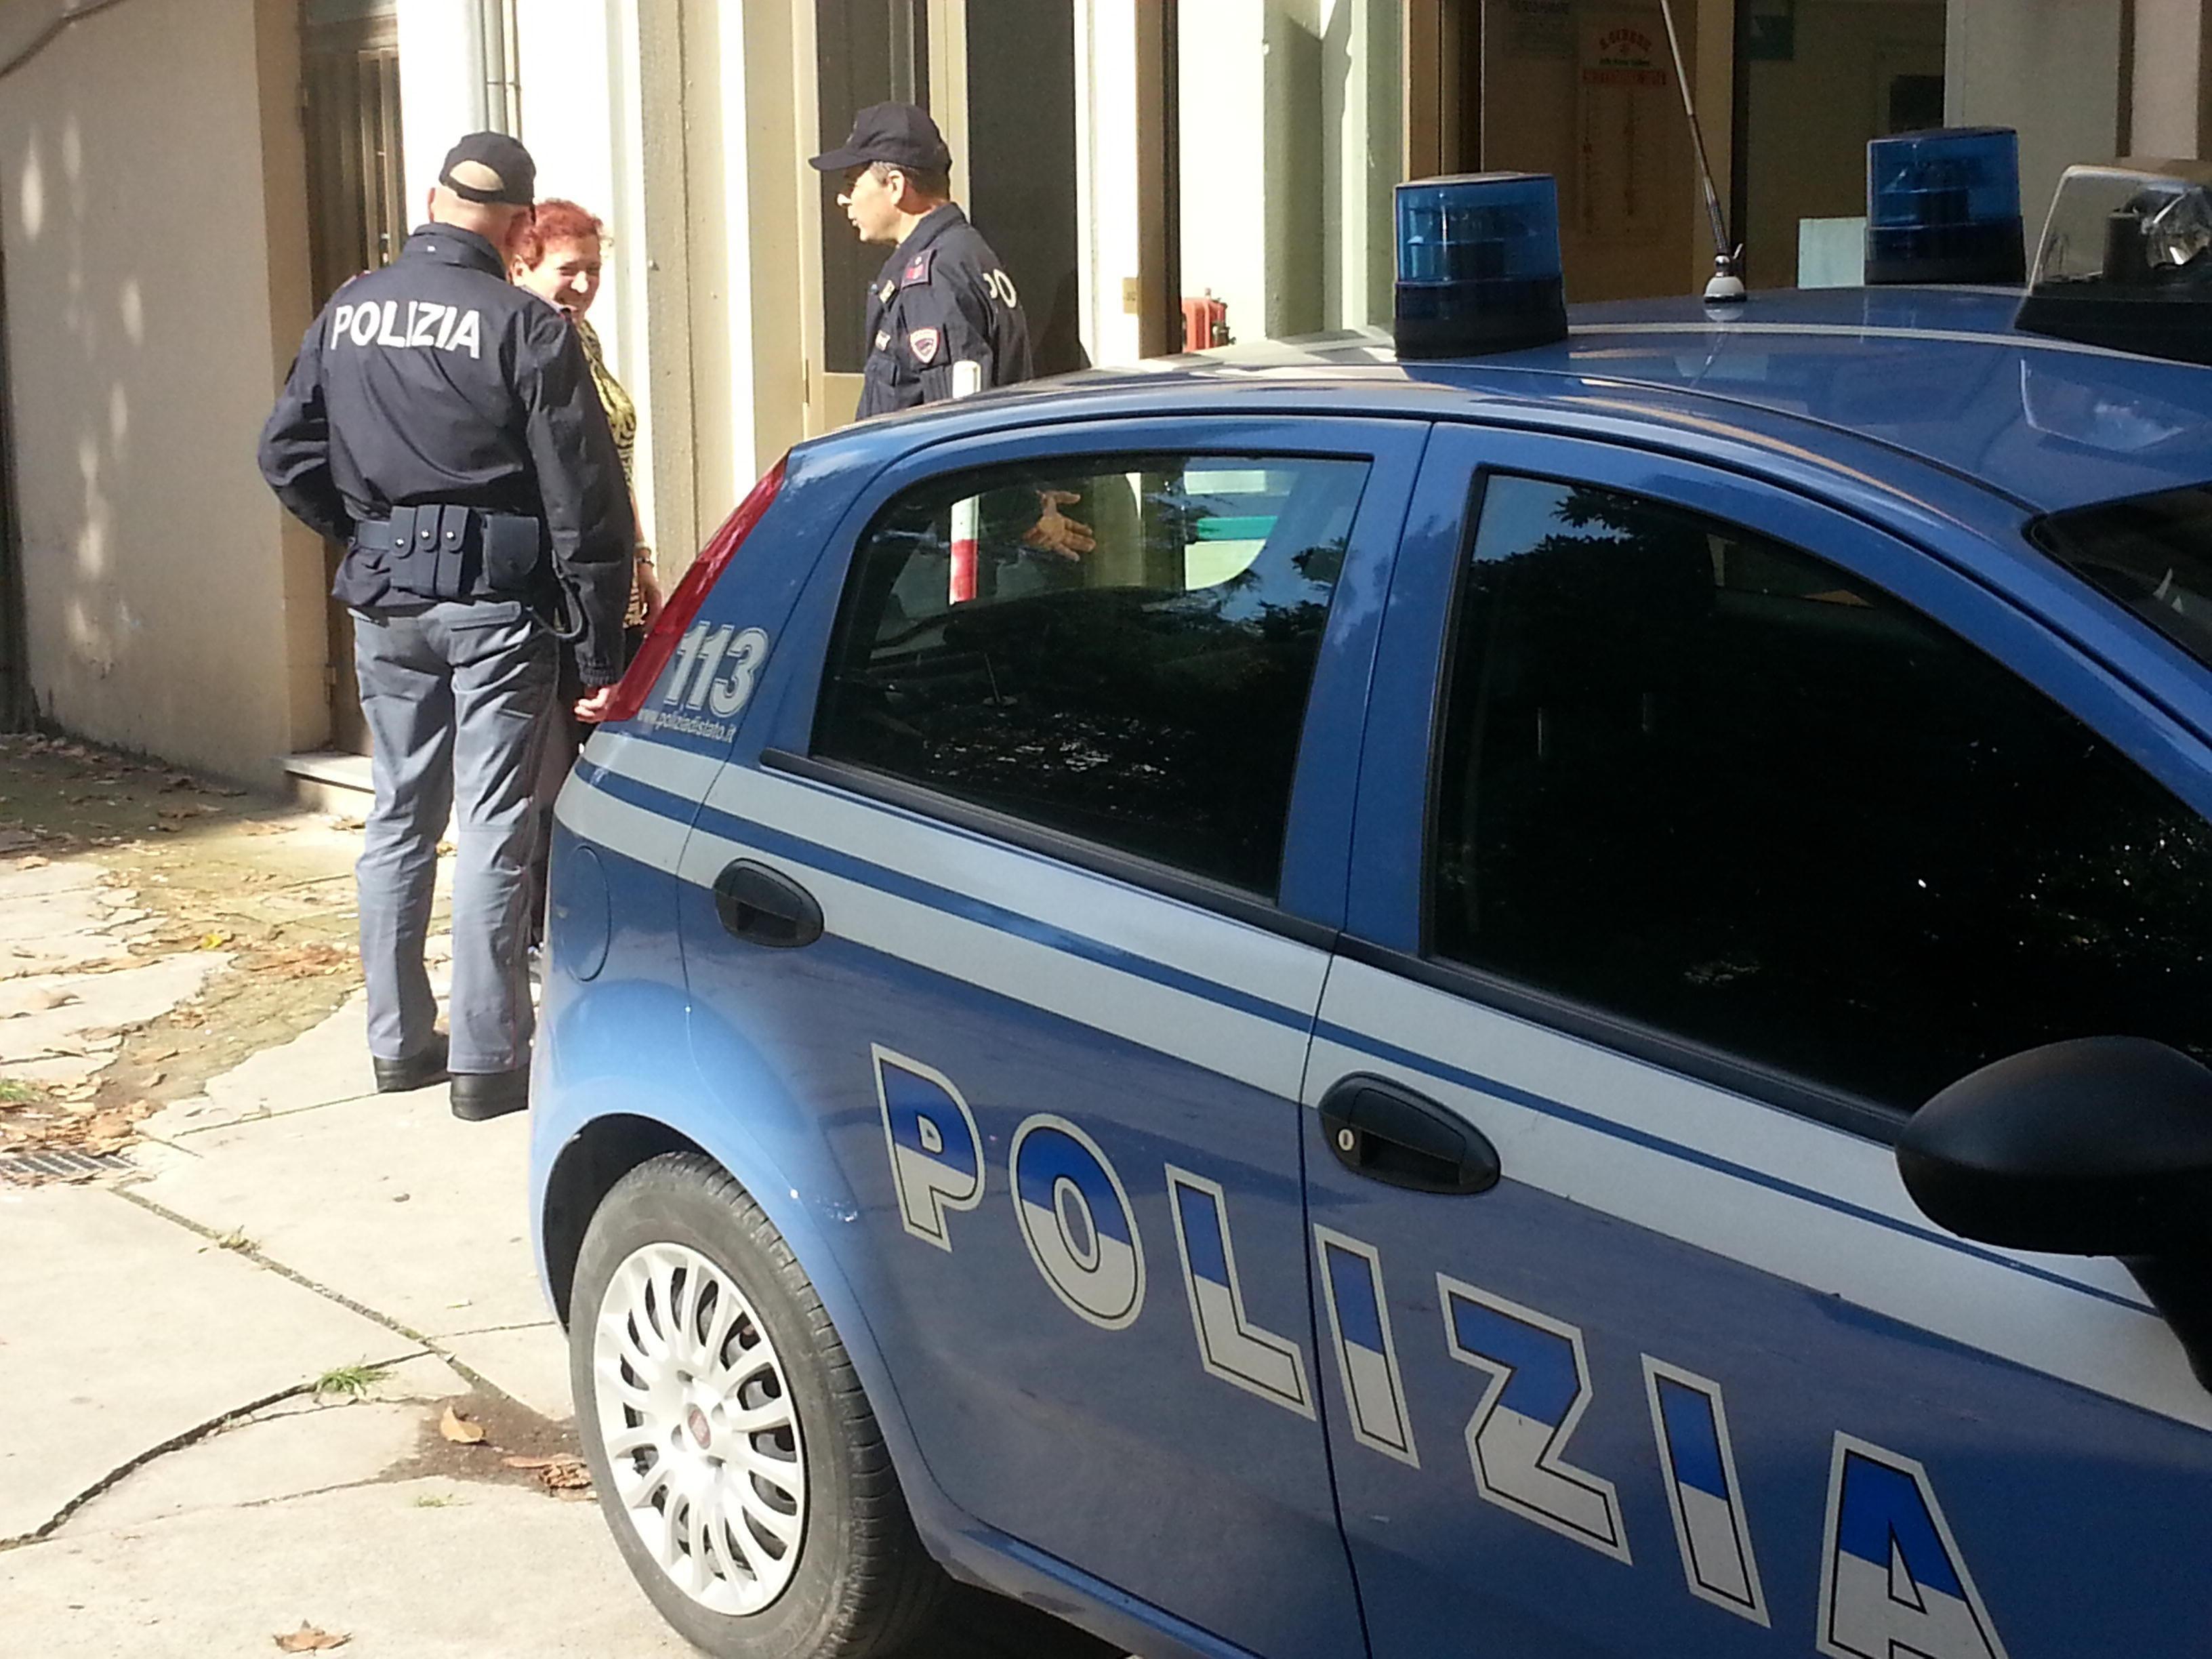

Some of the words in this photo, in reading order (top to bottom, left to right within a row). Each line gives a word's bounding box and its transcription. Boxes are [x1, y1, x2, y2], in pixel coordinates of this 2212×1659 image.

[331, 300, 480, 359] POLIZIA
[663, 619, 769, 718] 113
[869, 1042, 2009, 1659] POLIZIA
